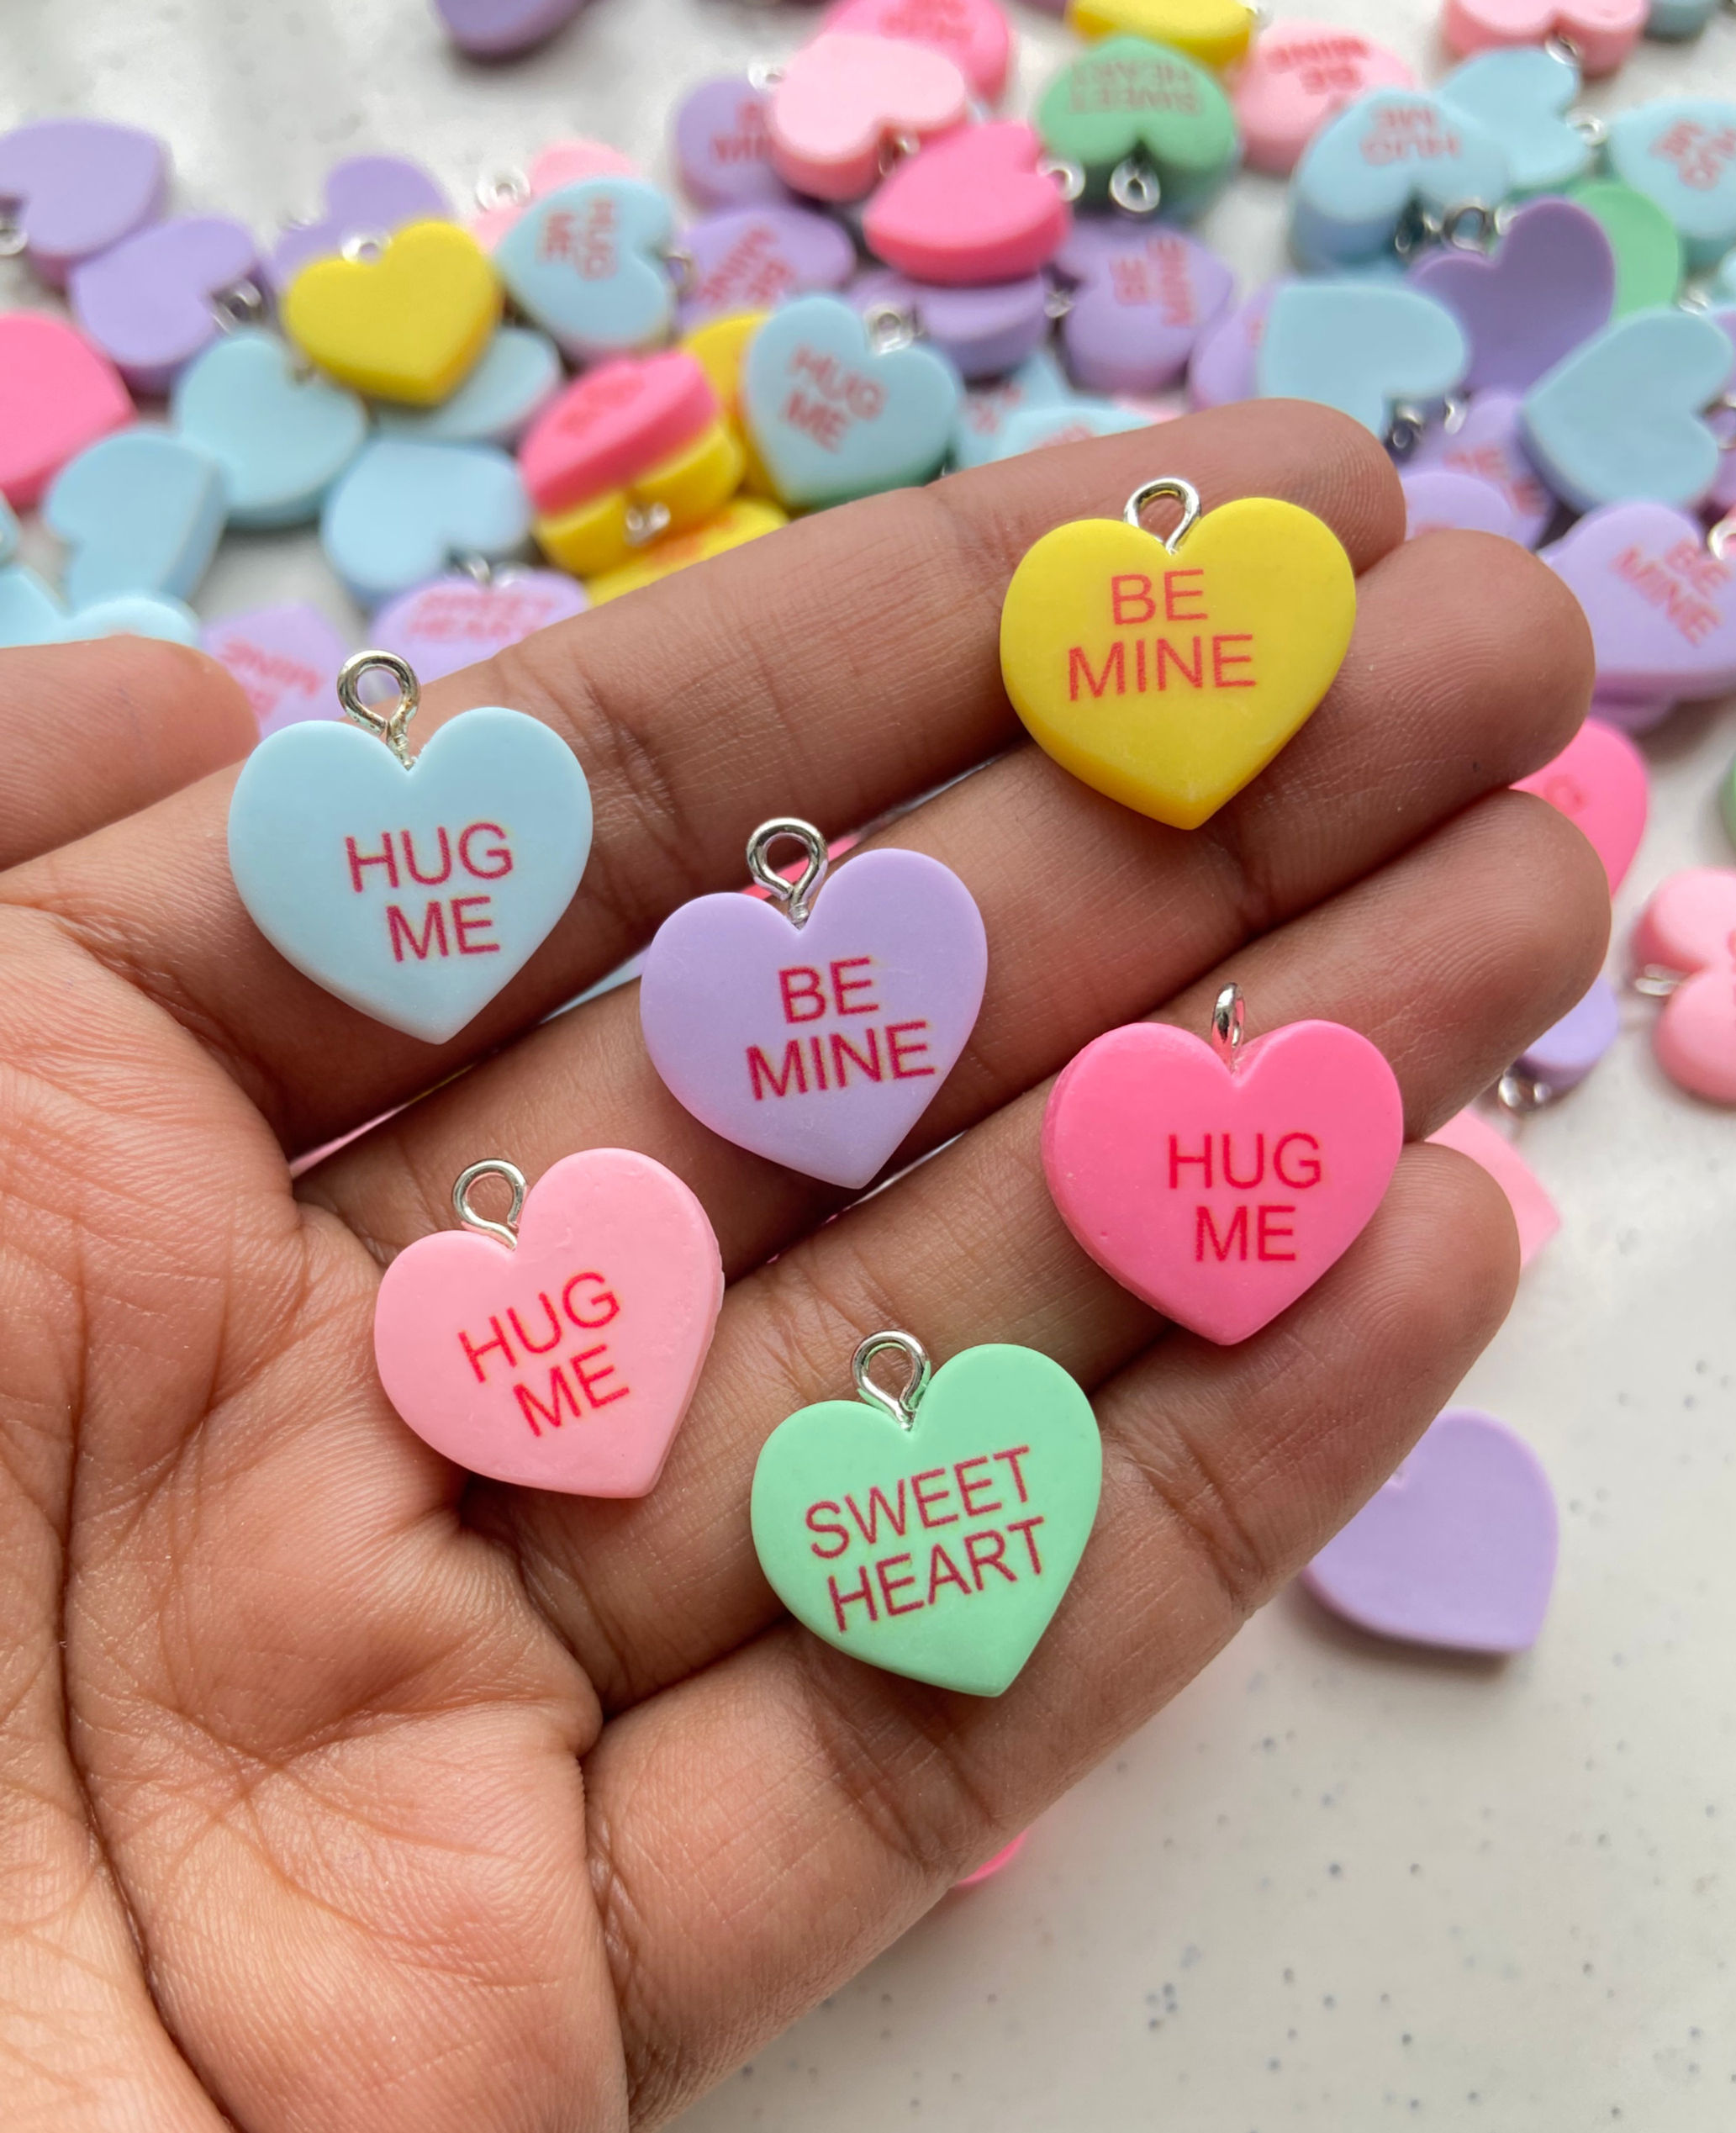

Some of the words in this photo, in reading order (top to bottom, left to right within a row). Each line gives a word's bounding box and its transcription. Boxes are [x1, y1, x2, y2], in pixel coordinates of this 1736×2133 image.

[787, 342, 888, 420] HUG
[779, 391, 847, 454] ME
[1111, 568, 1209, 626] BE
[1609, 547, 1723, 648] MINE
[1665, 540, 1732, 599] BE
[1068, 634, 1257, 702] MINE
[345, 821, 514, 893] HUG
[386, 895, 500, 963] ME
[778, 956, 879, 1024] BE
[745, 1020, 936, 1101] MINE
[1168, 1132, 1322, 1190] HUG
[1195, 1204, 1296, 1262] ME
[457, 1271, 620, 1384] HUG
[512, 1343, 630, 1438] ME
[805, 1444, 1030, 1560] SWEET
[826, 1515, 1045, 1633] HEART
